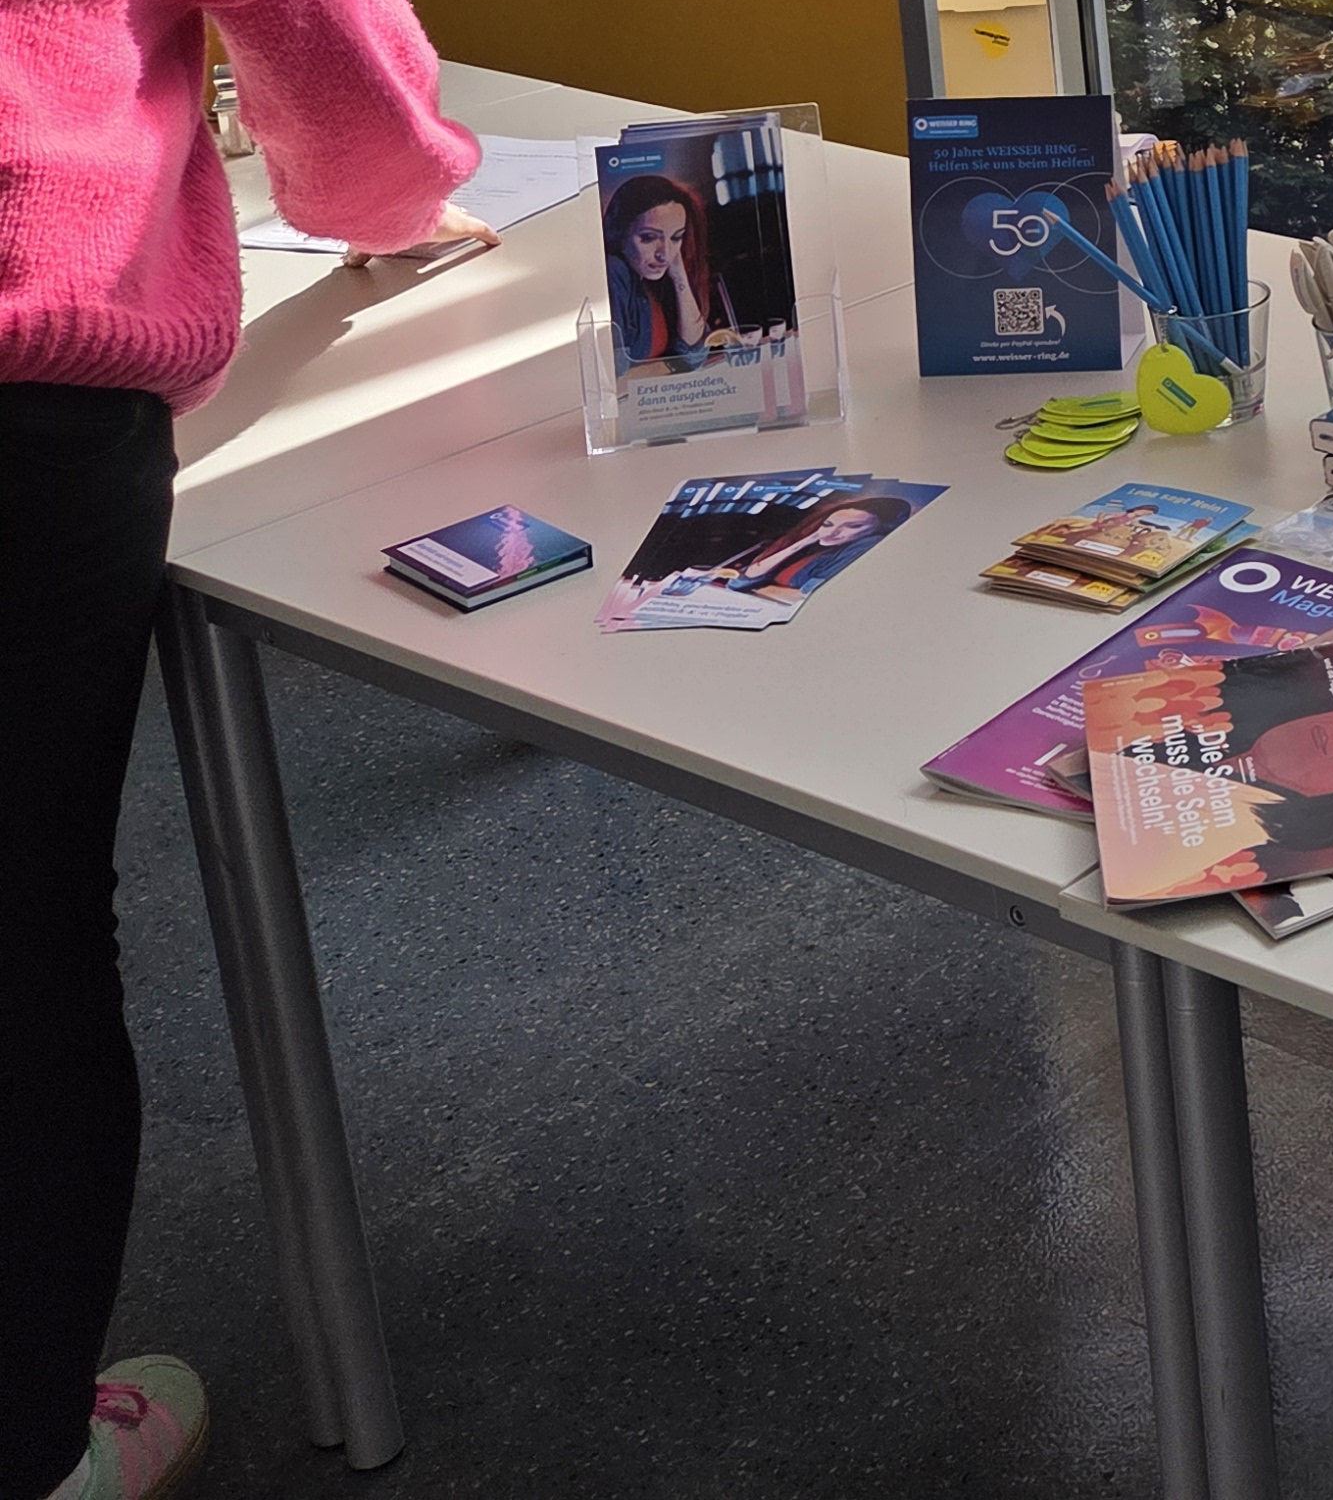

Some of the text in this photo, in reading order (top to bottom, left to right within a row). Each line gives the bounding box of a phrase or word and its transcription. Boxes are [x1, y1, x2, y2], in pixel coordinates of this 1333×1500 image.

[972, 350, 1070, 364] www.weisser-ring.de
[637, 376, 727, 396] Erst angestoßen,
[637, 385, 737, 408] dann ausgeknockt
[1161, 714, 1205, 848] muss die Seite
[1204, 763, 1237, 828] Scham
